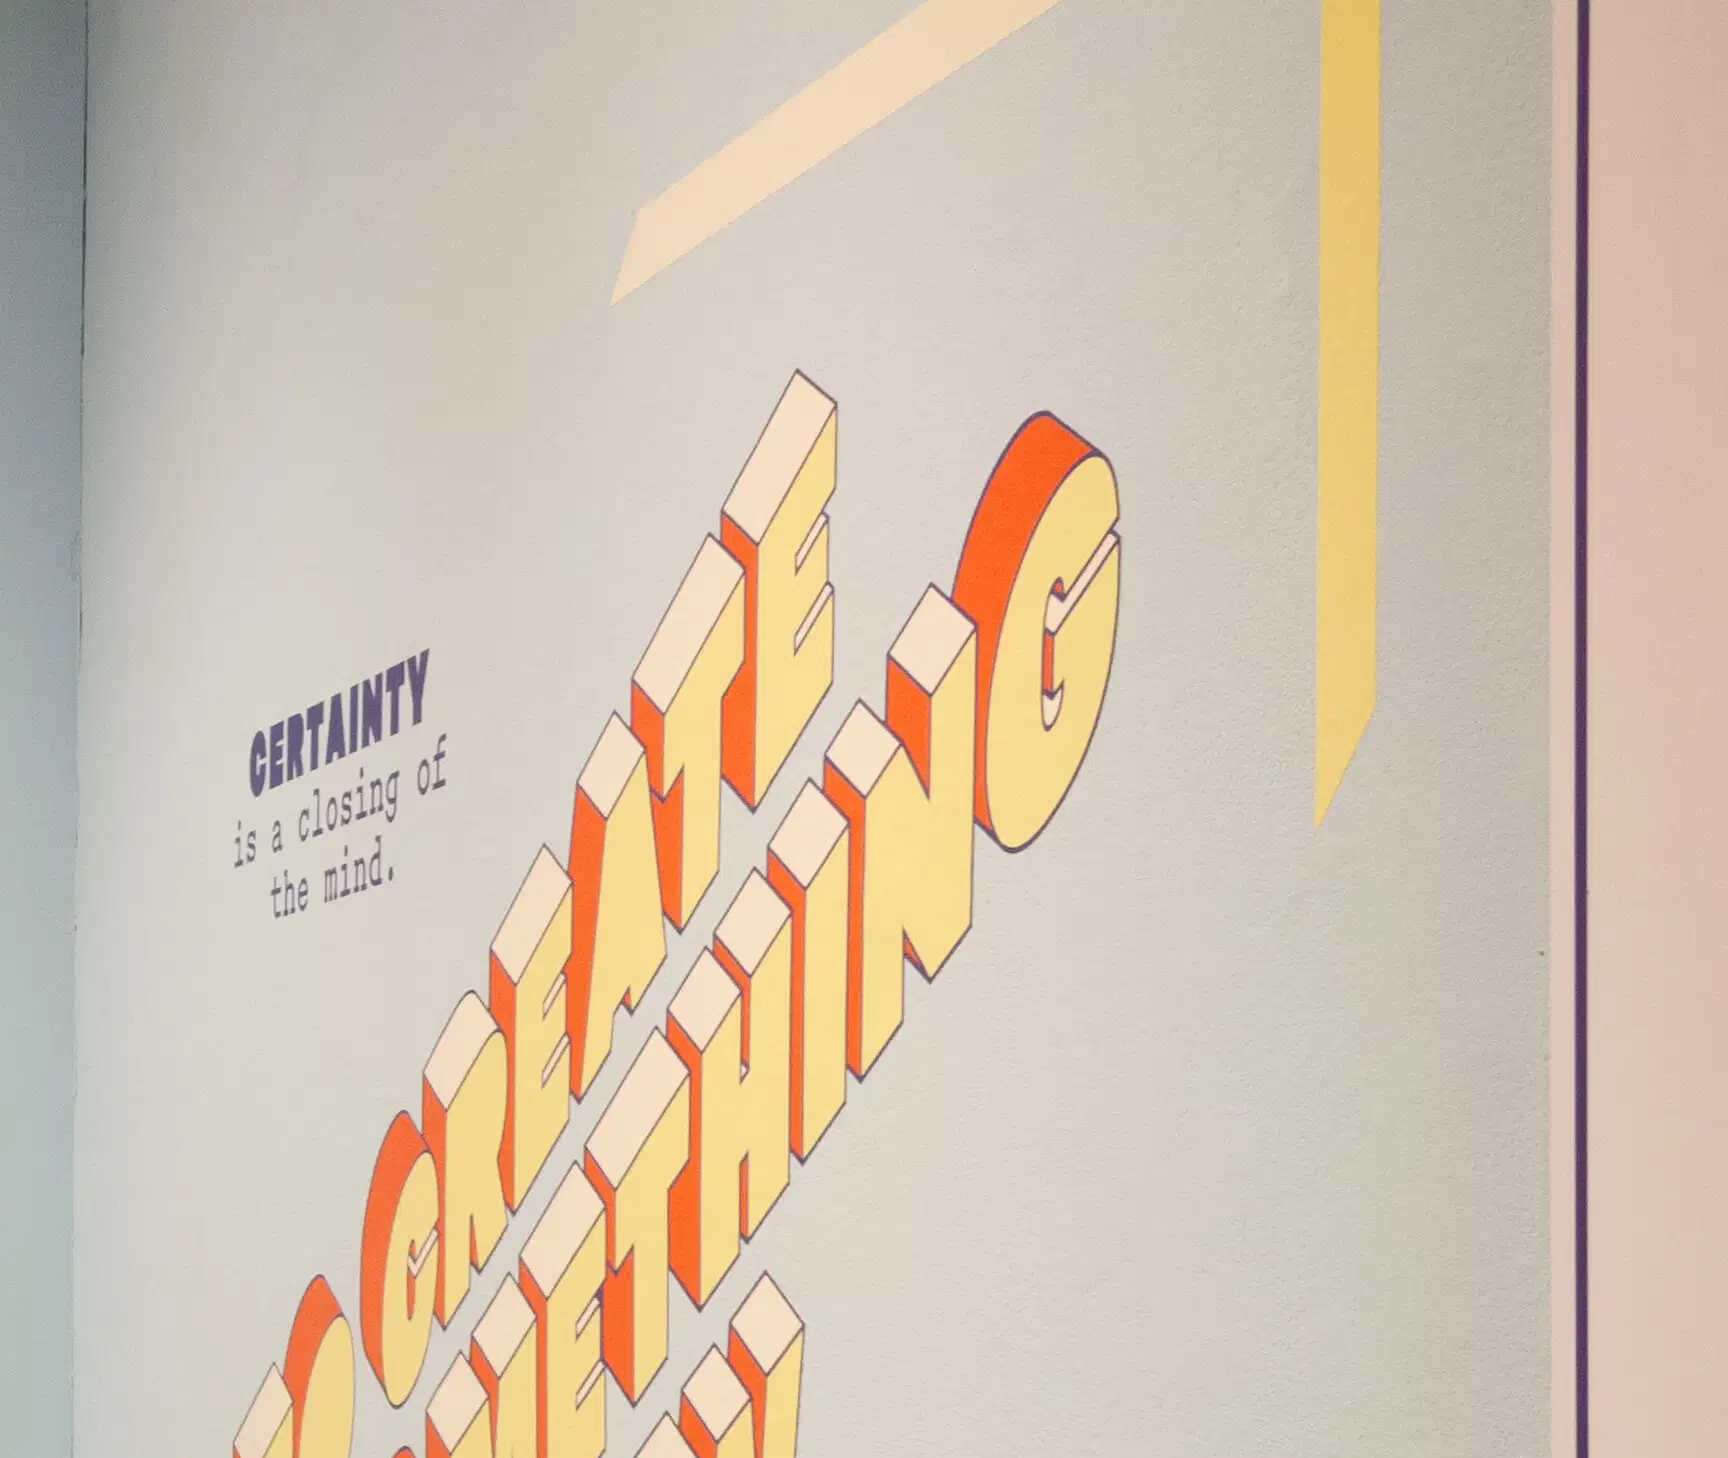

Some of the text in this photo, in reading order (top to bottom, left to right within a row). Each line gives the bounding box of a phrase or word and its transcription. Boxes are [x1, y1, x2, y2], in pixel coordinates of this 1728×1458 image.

[249, 648, 431, 798] CERTAINTY
[234, 733, 447, 869] is a closing of
[270, 835, 394, 919] the mind.
[361, 369, 837, 1406] CREATE
